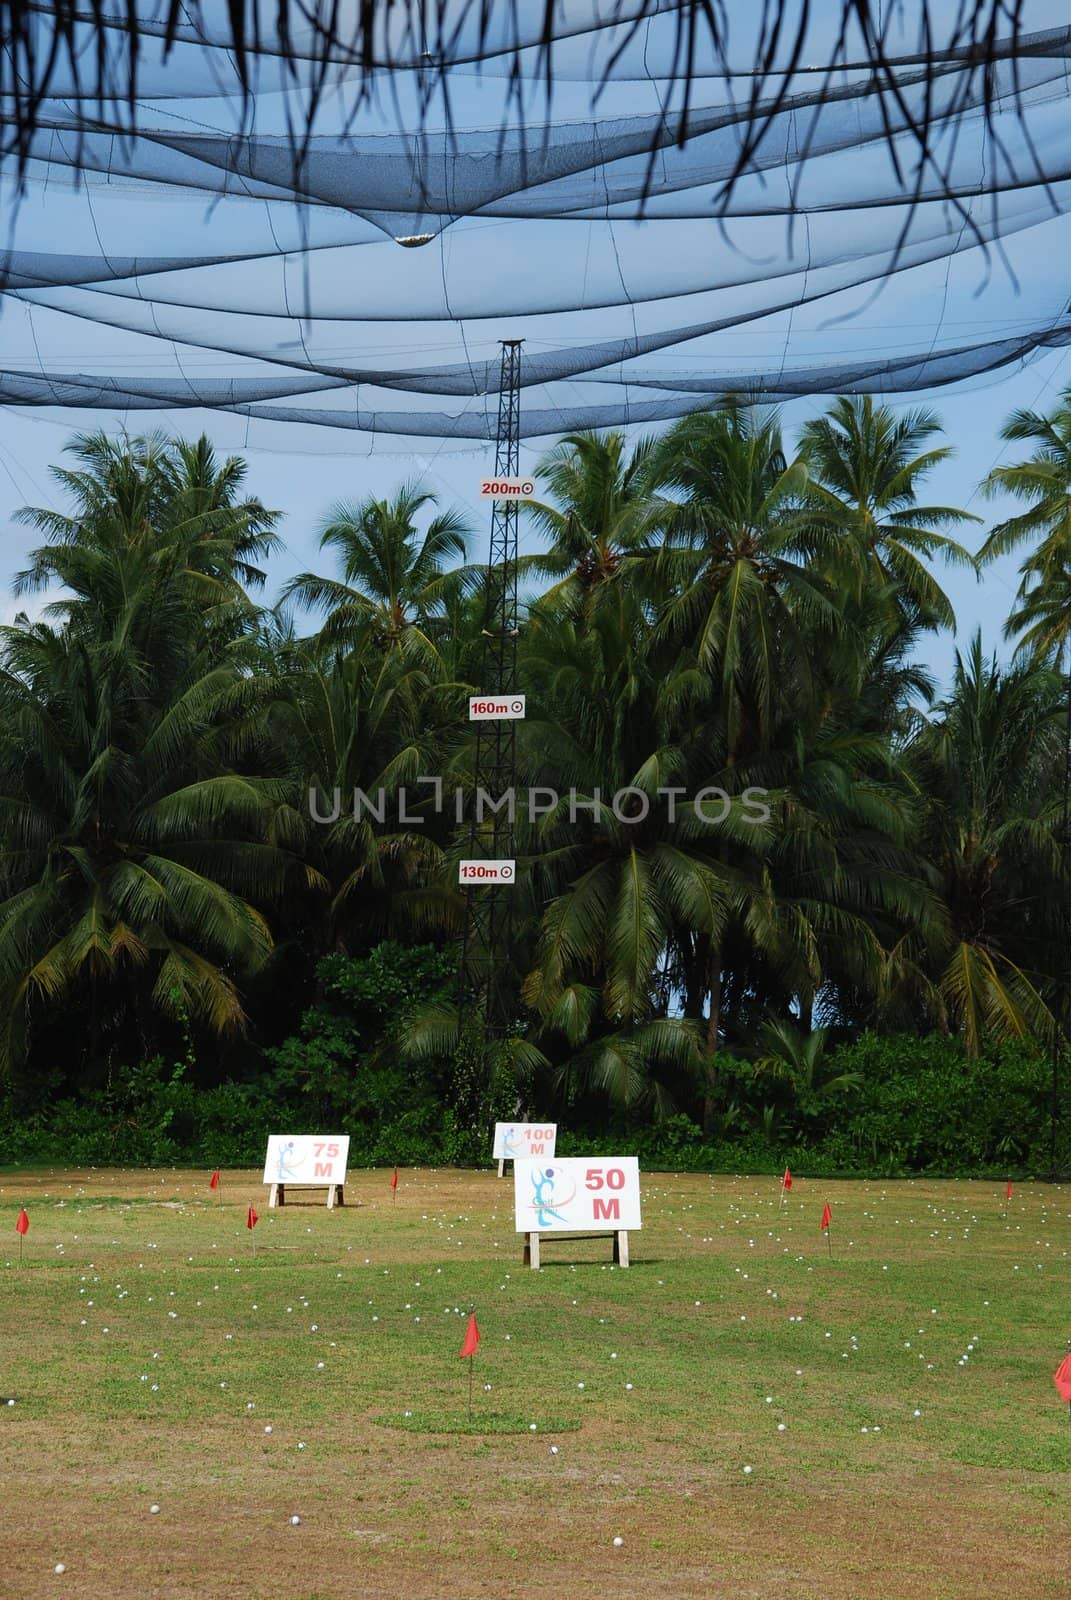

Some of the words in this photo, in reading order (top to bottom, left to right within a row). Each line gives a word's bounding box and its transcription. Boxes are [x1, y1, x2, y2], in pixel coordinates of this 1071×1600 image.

[482, 483, 521, 494] 200m
[472, 703, 508, 714] 160m
[461, 866, 498, 878] 130m
[524, 1128, 554, 1140] 100
[313, 1143, 340, 1158] 75
[530, 1143, 545, 1155] M
[313, 1162, 333, 1177] M
[585, 1168, 626, 1190] 50
[592, 1198, 620, 1220] M
